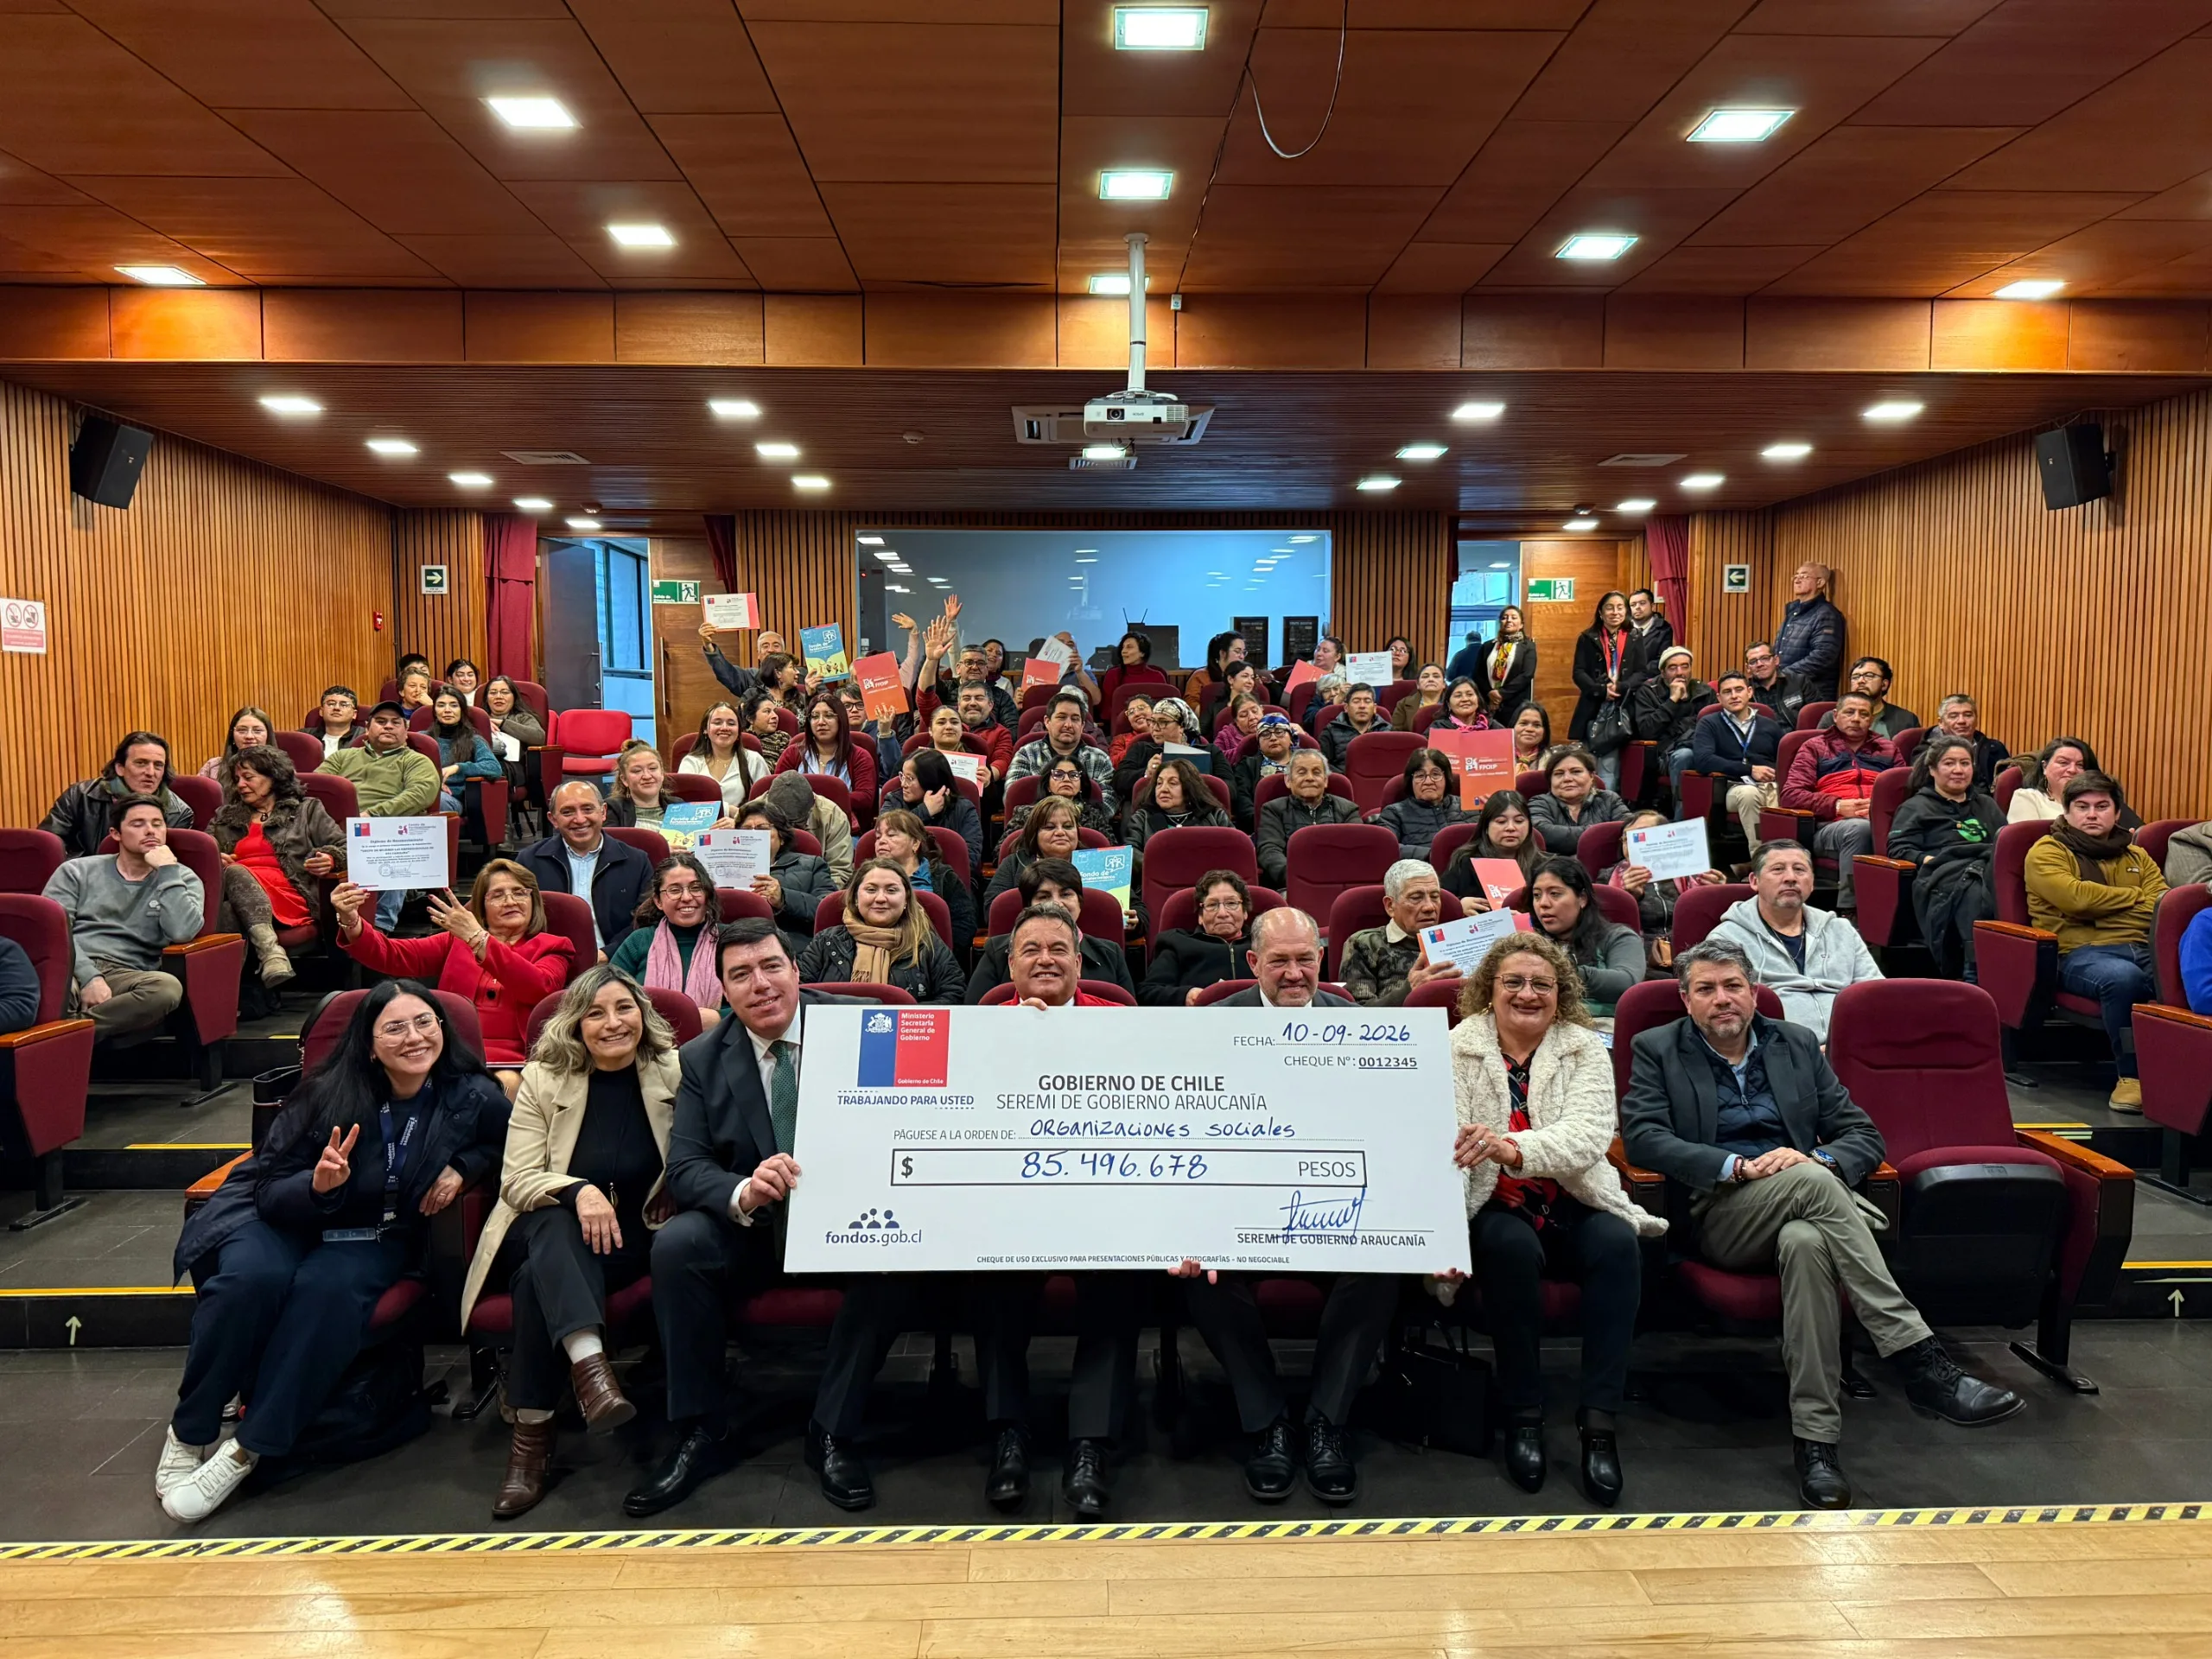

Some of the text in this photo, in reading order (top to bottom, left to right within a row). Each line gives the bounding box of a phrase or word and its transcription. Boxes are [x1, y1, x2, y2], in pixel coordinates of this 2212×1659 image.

[1233, 1037, 1276, 1046] FECHA:
[1284, 1056, 1334, 1067] CHEQUE
[1358, 1057, 1418, 1067] 0012345
[1039, 1075, 1225, 1091] GOBIERNO DE CHILE
[836, 1095, 975, 1105] TRABAJANDO PARA USTED
[996, 1094, 1056, 1109] SEREMI
[1061, 1094, 1083, 1109] DE
[1087, 1094, 1170, 1110] GOBIERNO
[939, 1130, 947, 1140] A
[950, 1130, 962, 1140] LA
[964, 1130, 998, 1140] ORDEN
[1001, 1130, 1016, 1140] DE:
[901, 1156, 913, 1178] $
[1298, 1160, 1357, 1178] PESOS
[825, 1229, 922, 1247] fondos.gob.cl
[1236, 1233, 1279, 1244] SEREMI
[1281, 1234, 1296, 1245] DE
[1300, 1234, 1357, 1246] GOBIERNO
